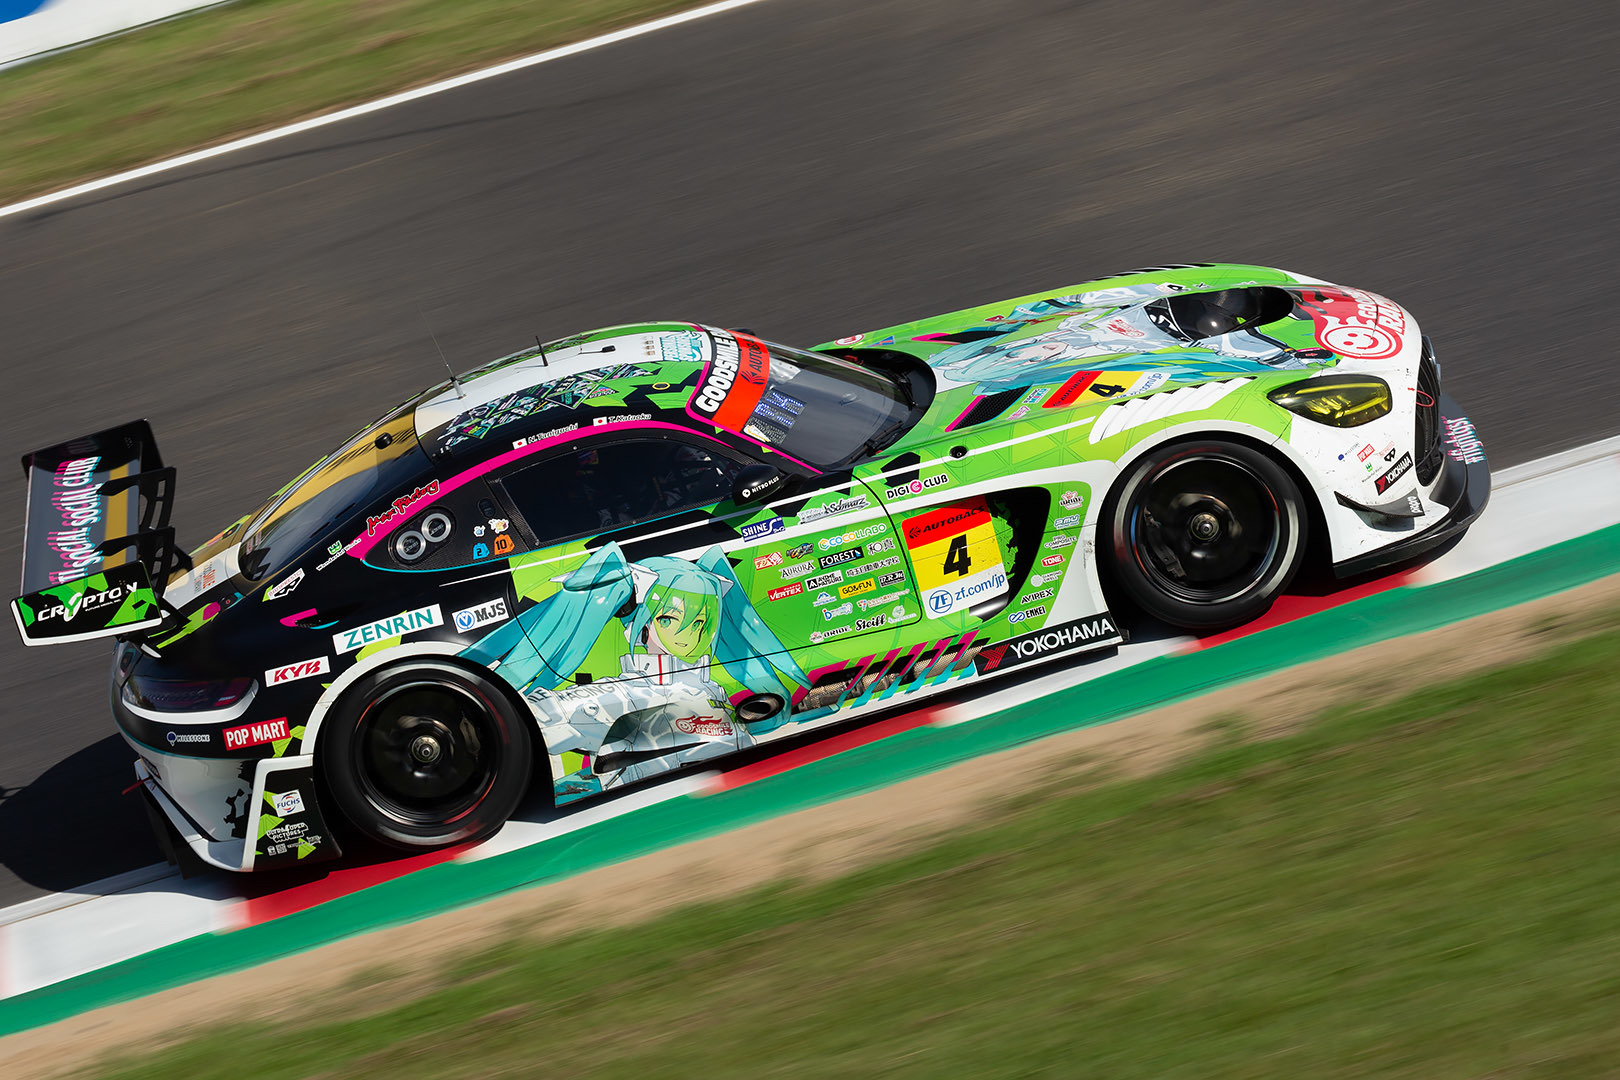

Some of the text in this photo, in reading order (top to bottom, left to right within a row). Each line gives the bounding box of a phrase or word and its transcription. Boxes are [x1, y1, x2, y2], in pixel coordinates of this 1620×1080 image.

[1089, 383, 1126, 398] 4
[1385, 456, 1412, 483] YOKOHAMA
[886, 485, 910, 499] DIGI
[923, 474, 948, 488] CLUB
[392, 479, 440, 515] Factory
[923, 505, 985, 533] AUTOBACS
[495, 540, 507, 551] 10
[820, 549, 856, 567] FOREST
[943, 534, 972, 577] 4
[1043, 556, 1062, 566] TONE
[781, 562, 815, 579] AURORA
[769, 586, 802, 601] VERTEX
[842, 580, 872, 595] GO&FUN
[955, 573, 1006, 601] zf.com/jp
[1021, 588, 1053, 604] AVIREX
[930, 592, 951, 611] ZF
[474, 602, 506, 623] MJS
[1026, 606, 1046, 618] ENKEI
[343, 608, 433, 650] ZENRIN
[855, 614, 886, 631] Steiff
[1010, 618, 1115, 659] YOKOHAMA
[273, 660, 321, 682] KYB
[558, 684, 615, 702] RACING
[225, 720, 286, 748] POP MART
[276, 798, 301, 809] FUCHS
